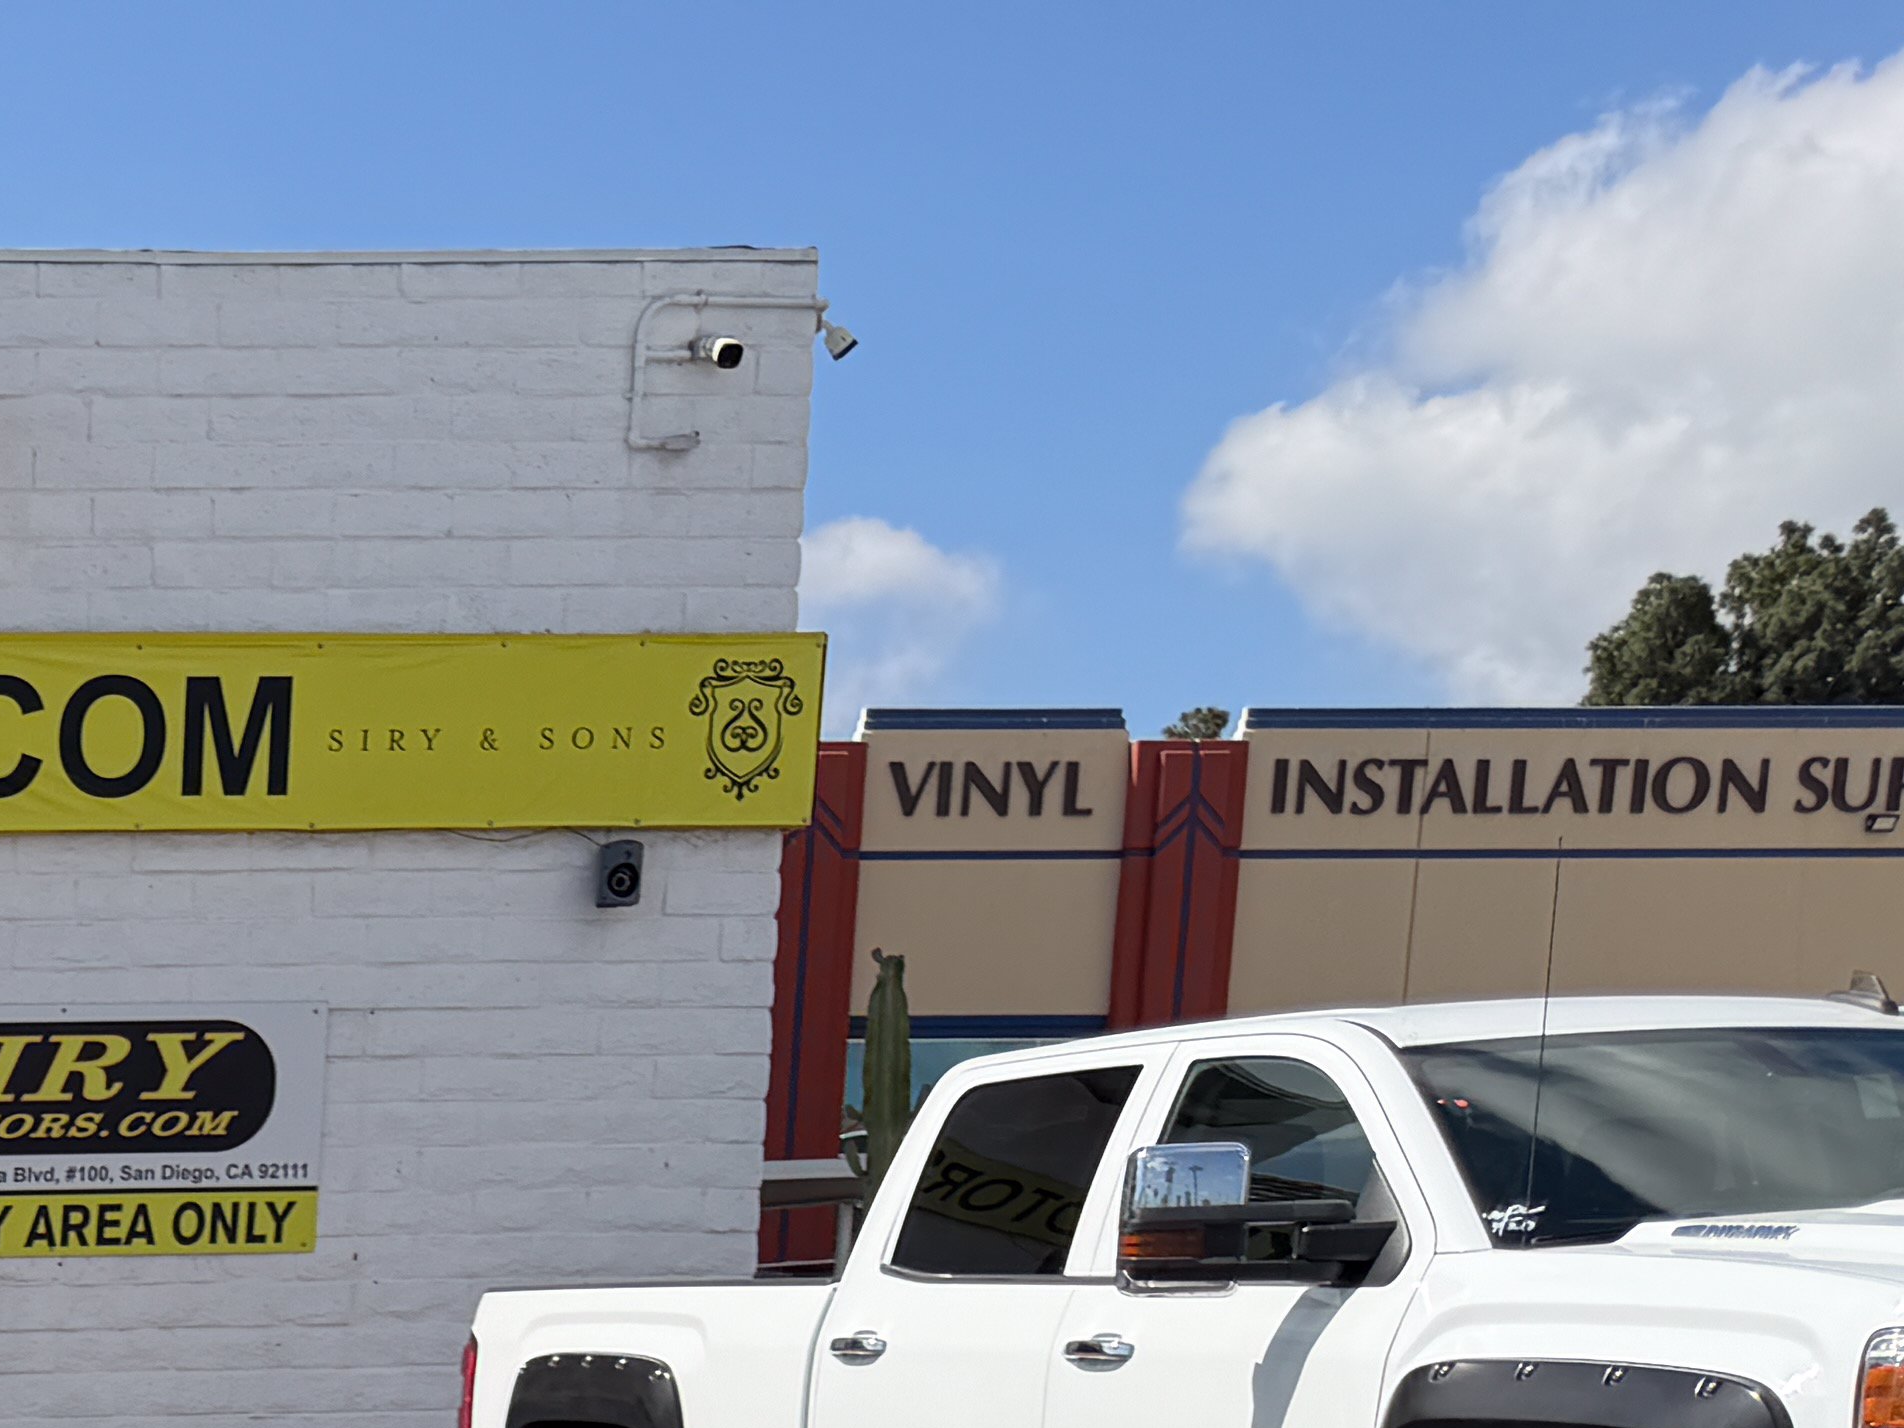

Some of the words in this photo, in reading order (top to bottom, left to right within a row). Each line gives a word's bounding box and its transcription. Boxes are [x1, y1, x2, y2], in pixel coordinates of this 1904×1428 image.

[328, 728, 442, 752] SIRY
[479, 729, 499, 752] &
[539, 726, 666, 751] SONS
[888, 761, 1094, 819] VINYL
[1271, 756, 1770, 816] INSTALLATION
[13, 1165, 59, 1185] Blvd,
[65, 1165, 114, 1183] #100,
[119, 1164, 156, 1182] San
[162, 1163, 220, 1184] Diego,
[225, 1163, 253, 1180] CA
[258, 1162, 309, 1179] 92111
[23, 1203, 156, 1248] AREA
[171, 1200, 297, 1246] ONLY
